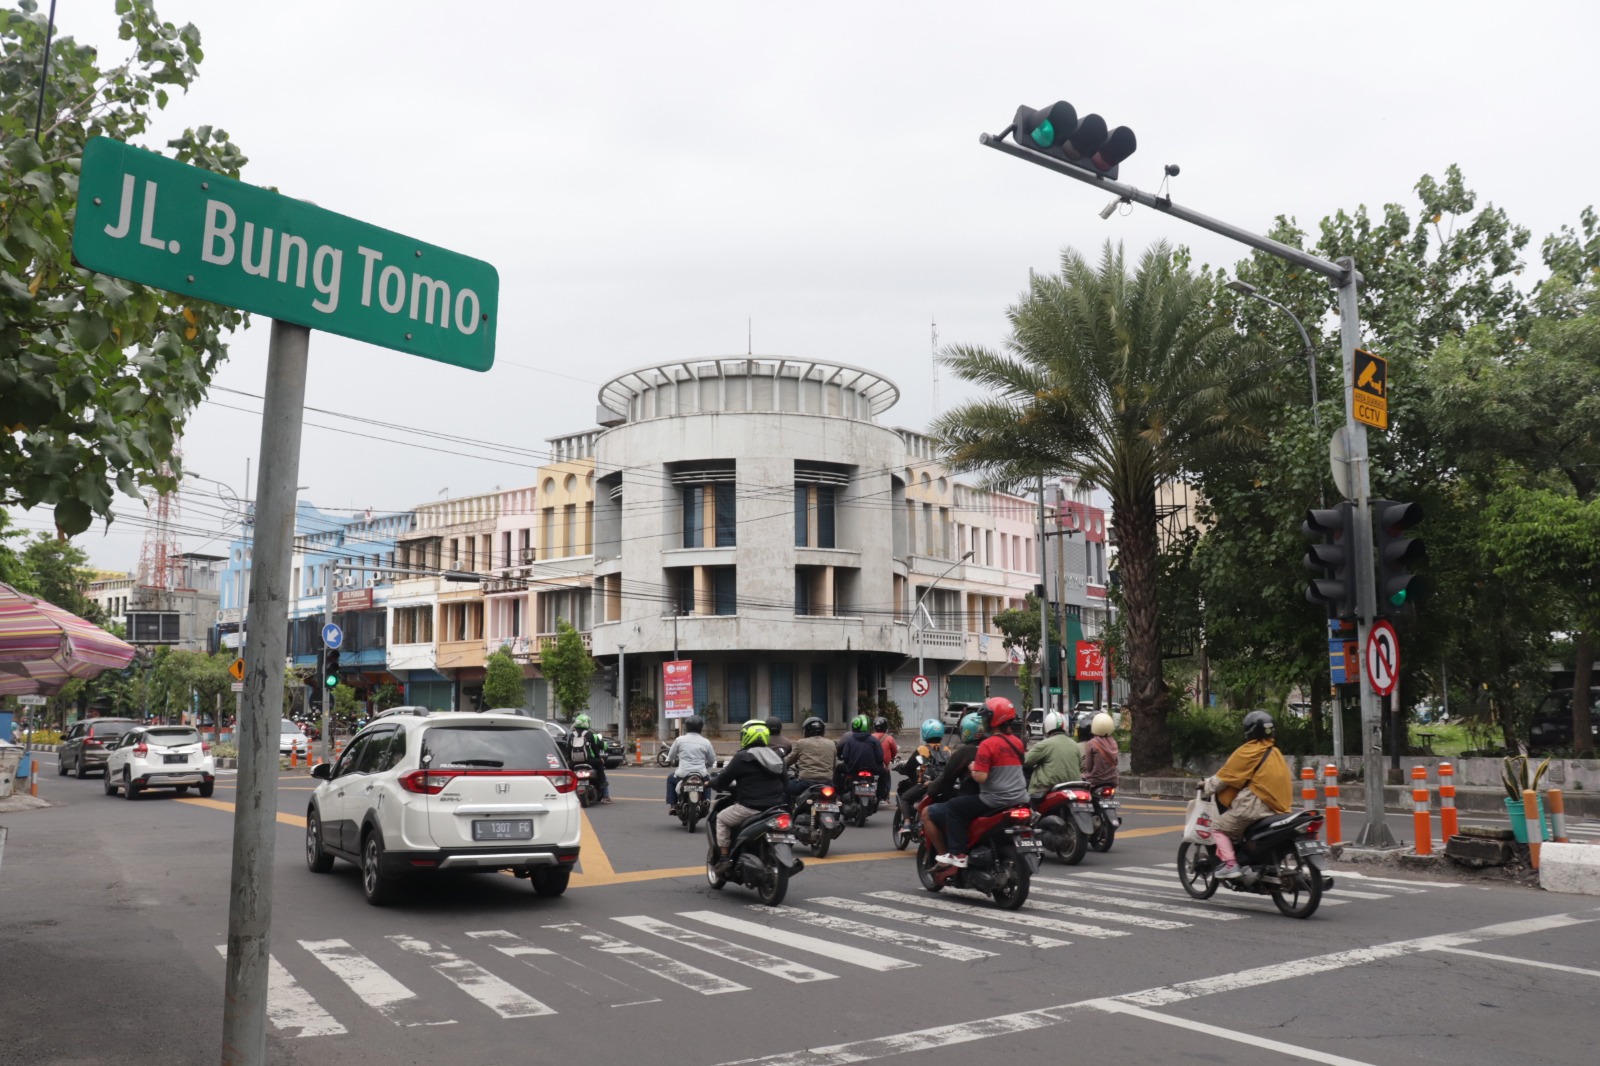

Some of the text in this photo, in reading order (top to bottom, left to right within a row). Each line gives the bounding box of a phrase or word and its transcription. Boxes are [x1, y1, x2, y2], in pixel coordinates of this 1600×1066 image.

[103, 173, 480, 335] JL. Bung Tomo
[1358, 404, 1380, 422] CCTV
[476, 822, 530, 834] L 1307 FG
